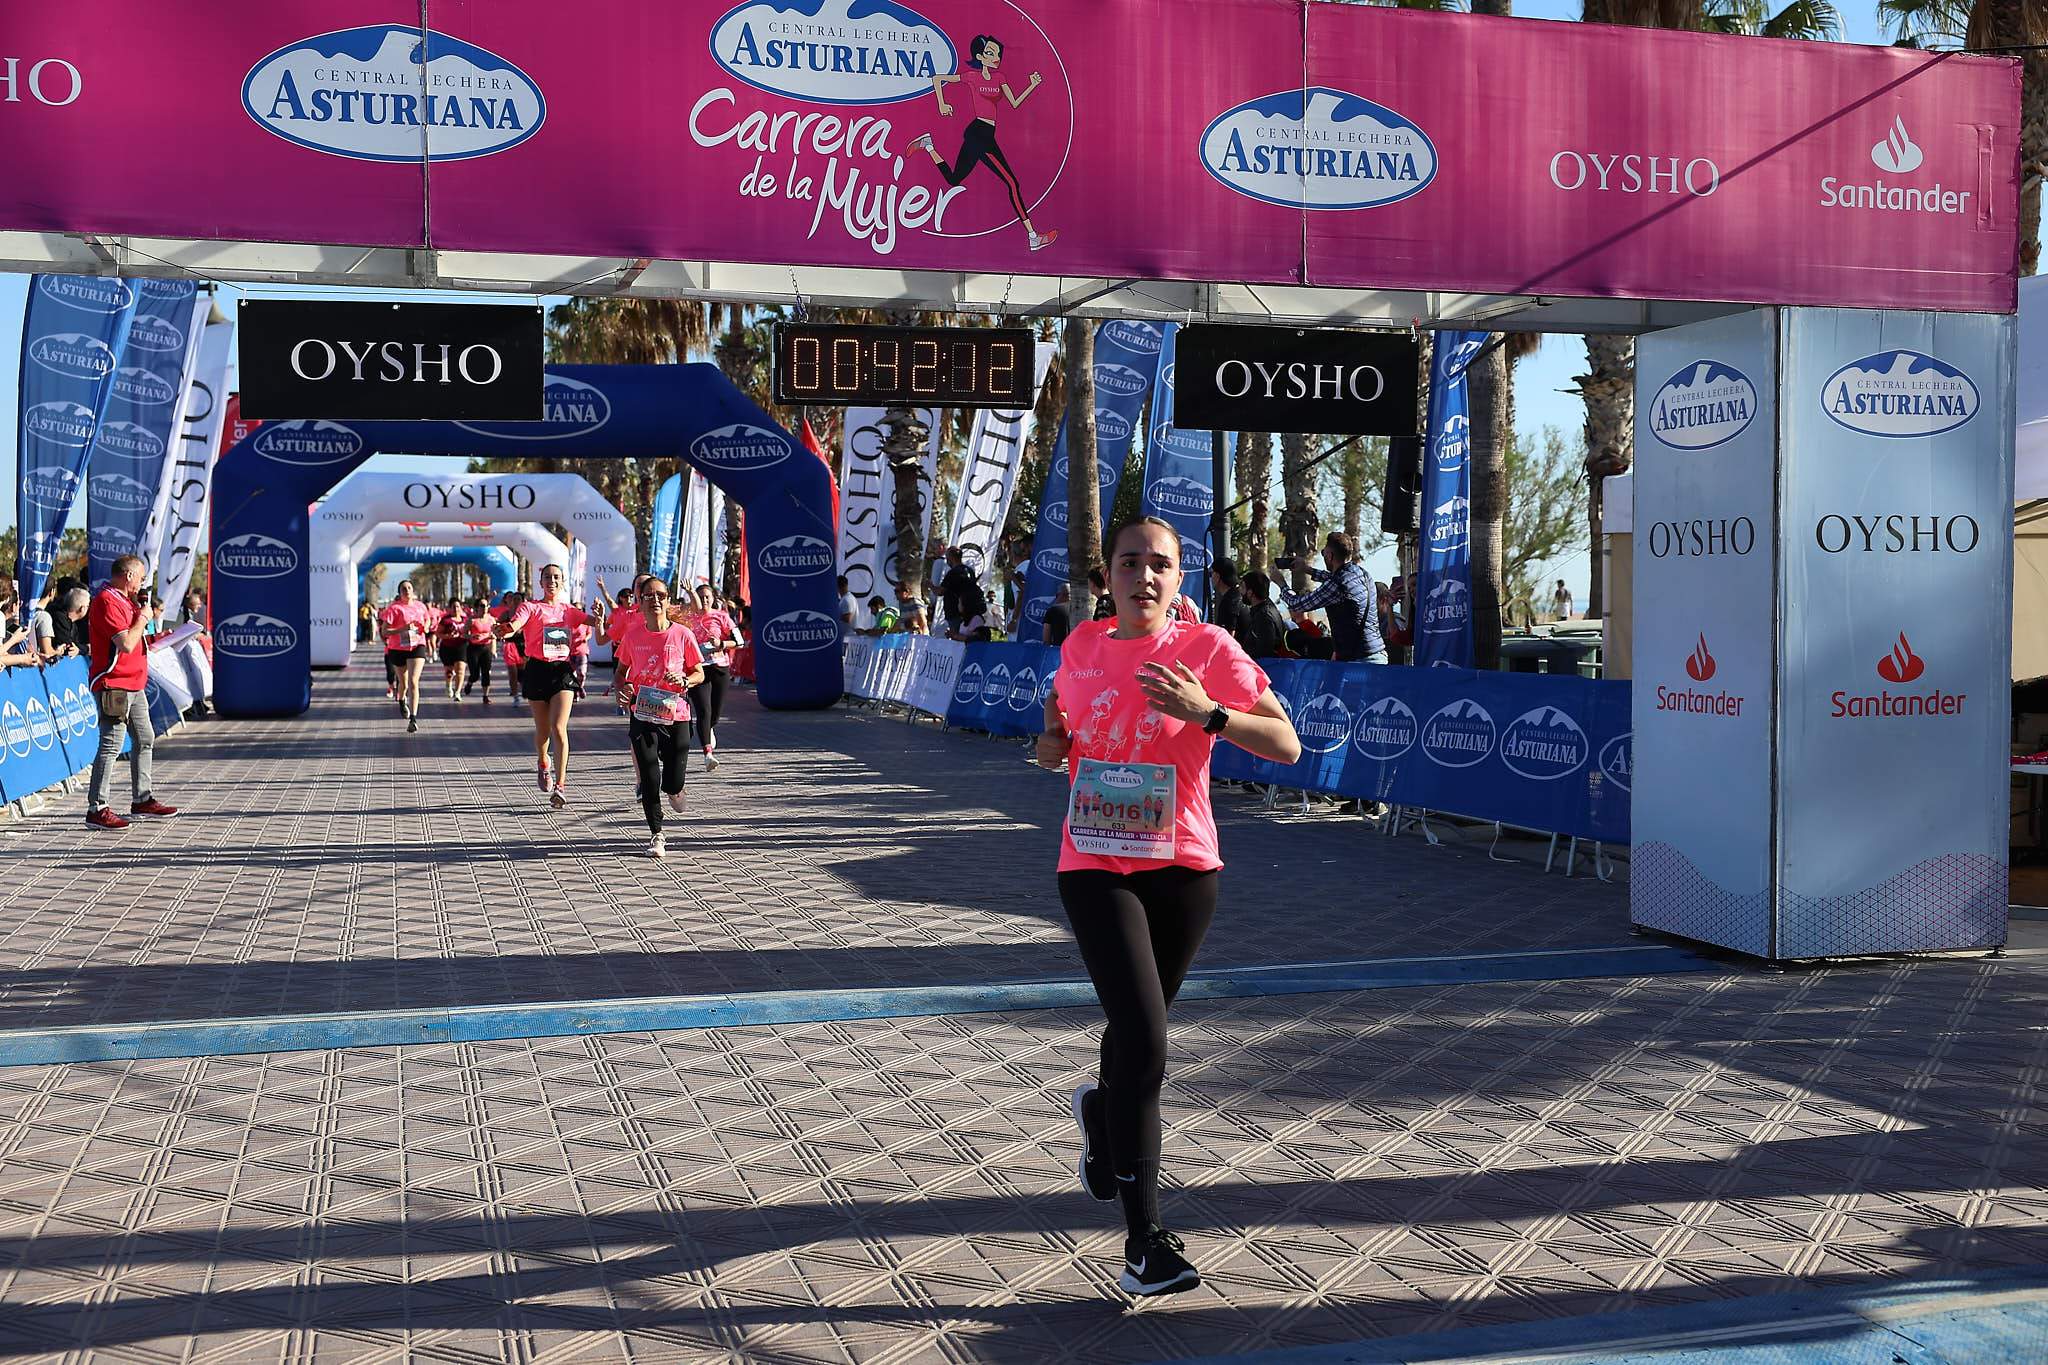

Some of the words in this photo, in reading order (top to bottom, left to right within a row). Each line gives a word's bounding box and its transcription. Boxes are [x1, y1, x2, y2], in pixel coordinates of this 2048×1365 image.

[768, 22, 846, 38] CENTRAL
[855, 29, 931, 44] LECHERA
[730, 22, 937, 79] ASTURIANA
[314, 68, 408, 86] CENTRAL
[267, 69, 524, 131] ASTURIANA
[689, 88, 891, 158] Carrera
[1255, 126, 1331, 141] CENTRAL
[1337, 131, 1413, 147] LECHERA
[1219, 127, 1418, 183] ASTURIANA
[1550, 150, 1720, 198] OYSHO
[739, 155, 777, 197] de
[786, 157, 812, 200] la
[807, 155, 966, 254] Mujer
[1820, 178, 1971, 215] Santander
[290, 338, 502, 385] OYSHO
[793, 338, 1014, 394] 00:42:12
[114, 382, 167, 400] STURIANA
[1215, 360, 1384, 402] OYSHO
[1671, 392, 1706, 404] CENTRAL
[1706, 385, 1746, 399] LECHERA
[1857, 380, 1907, 389] CENTRAL
[1911, 381, 1963, 391] LECHERA
[1833, 381, 1968, 416] ASTURIANA
[1656, 398, 1749, 432] ASTURIANA
[260, 434, 354, 454] ASTURIANA
[699, 442, 785, 459] ASTURIANA
[1159, 432, 1212, 452] ASTURIA
[404, 482, 535, 510] OYSHO
[322, 512, 364, 521] OYSHO
[573, 511, 612, 520] OYSHO
[844, 425, 885, 599] OYSHO
[1650, 517, 1755, 557] OYSHO
[1815, 514, 1979, 553] OYSHO
[218, 550, 292, 568] ASTURIANA
[593, 564, 630, 574] OYSHO
[764, 552, 830, 568] ASTURIANA
[217, 629, 291, 646] ASTURIANA
[768, 626, 835, 642] ASTURIANA
[1657, 685, 1744, 717] Santander
[1831, 690, 1967, 718] Santander
[1357, 718, 1410, 745] ASTURIANA
[1425, 726, 1488, 752] ASTURIANA
[1504, 729, 1577, 764] ASTURIANA
[1073, 828, 1098, 836] CARRERA
[1115, 831, 1135, 839] MUJER
[1139, 833, 1167, 841] VALENCIA
[1077, 839, 1110, 850] OYSHO
